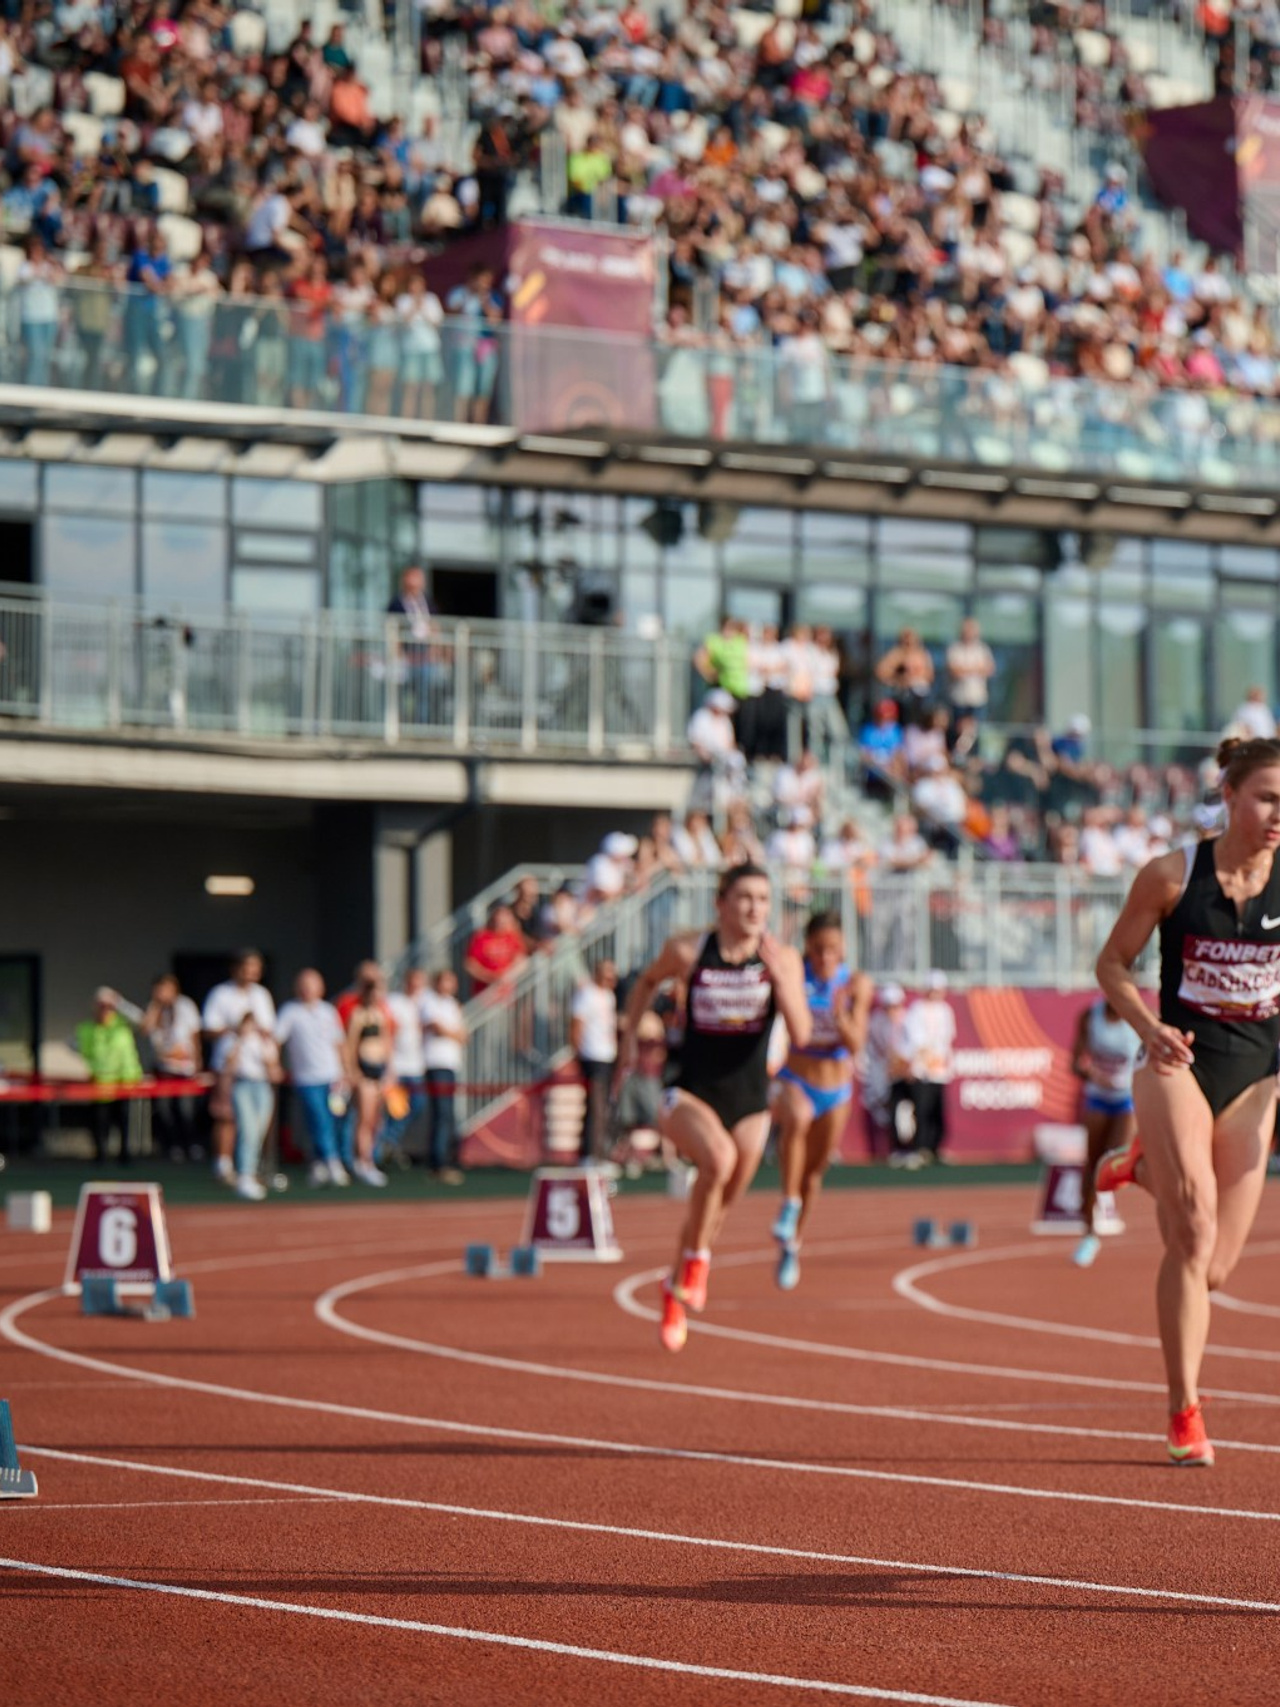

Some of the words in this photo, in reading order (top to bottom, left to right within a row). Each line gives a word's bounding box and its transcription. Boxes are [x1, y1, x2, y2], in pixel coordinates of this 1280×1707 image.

[547, 1187, 580, 1239] 5
[1053, 1168, 1083, 1213] 4
[98, 1206, 138, 1268] 6
